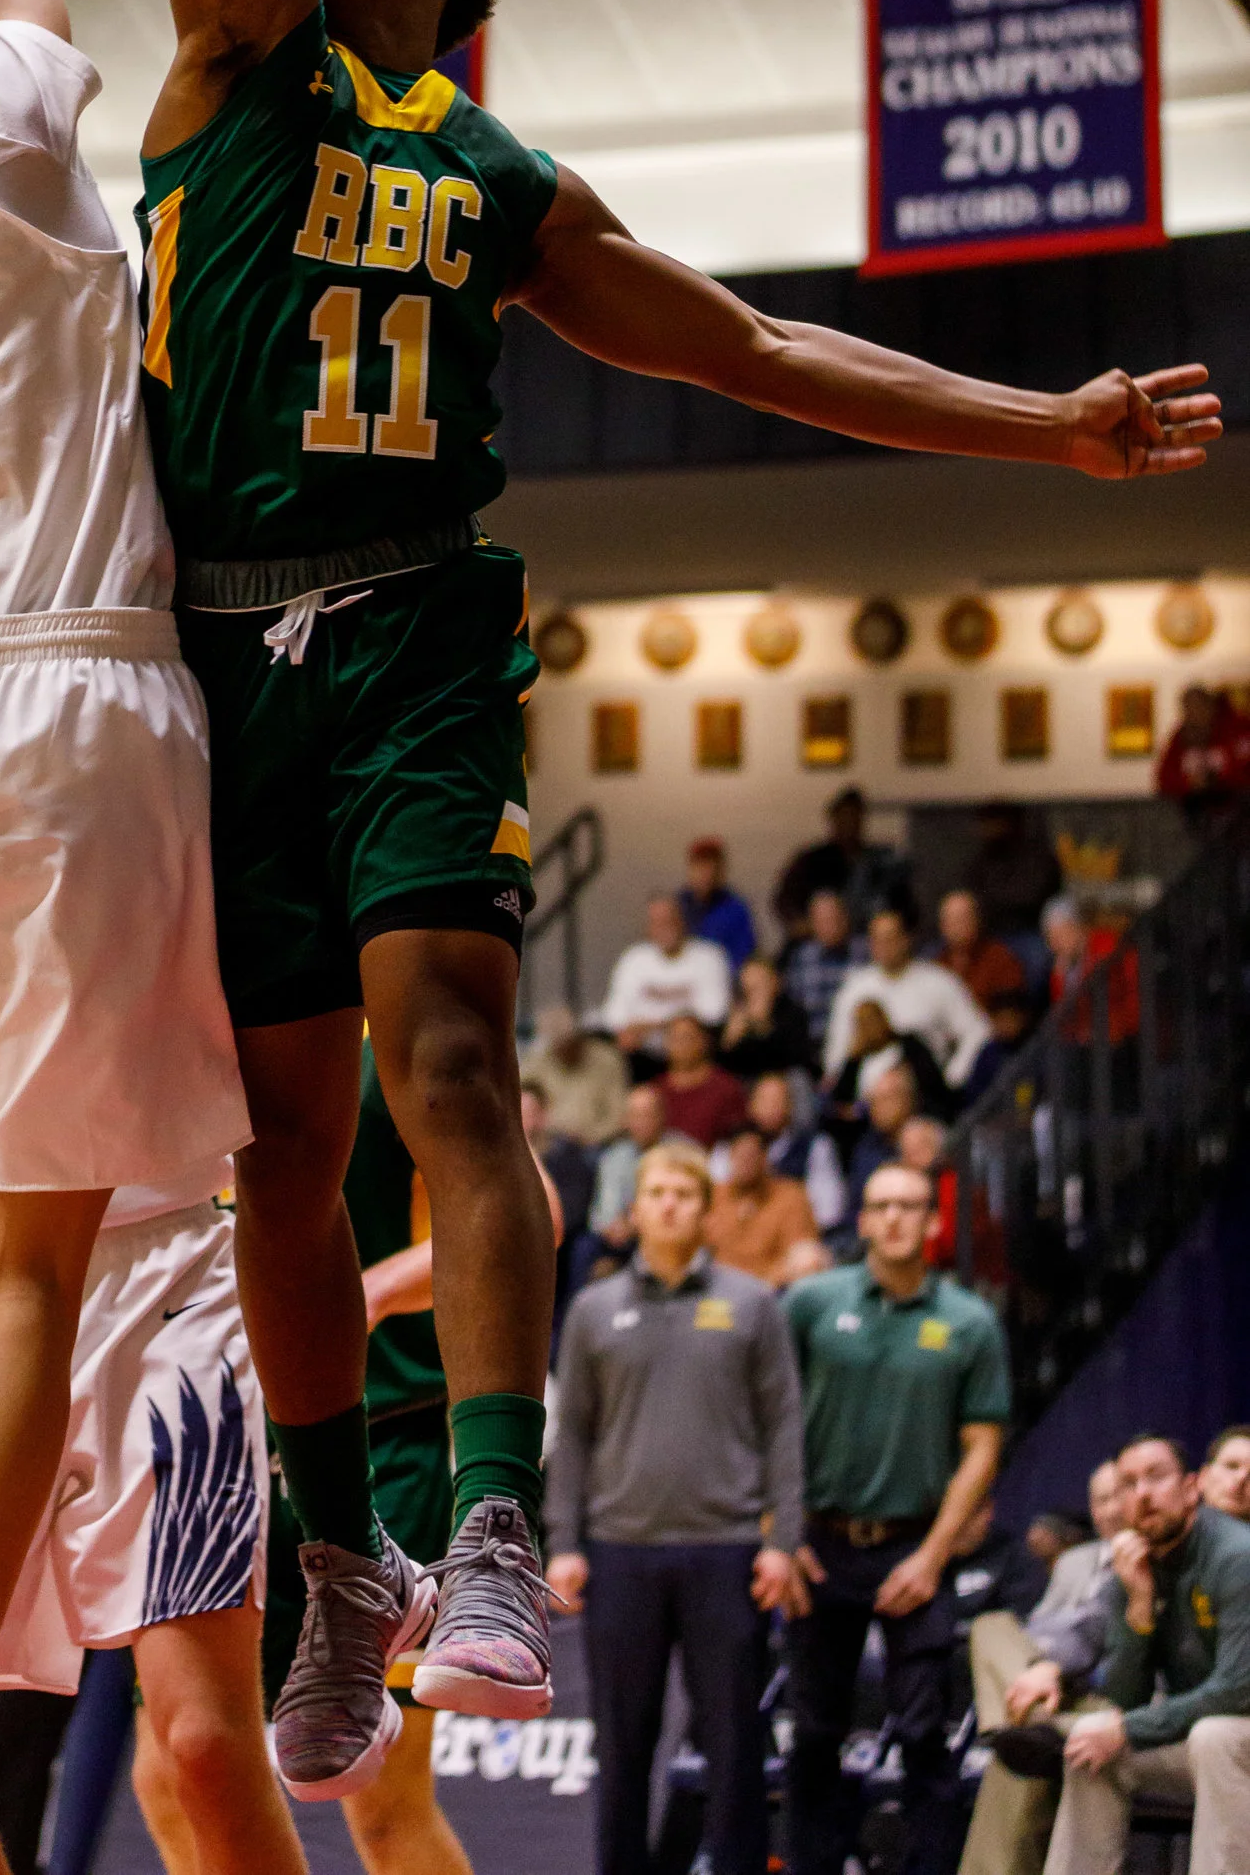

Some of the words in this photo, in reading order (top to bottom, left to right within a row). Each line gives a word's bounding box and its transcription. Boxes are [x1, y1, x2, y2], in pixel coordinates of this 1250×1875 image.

[881, 42, 1142, 111] CHAMPIONS
[942, 104, 1082, 181] 2010
[293, 143, 483, 290] RBC
[302, 285, 438, 460] 11
